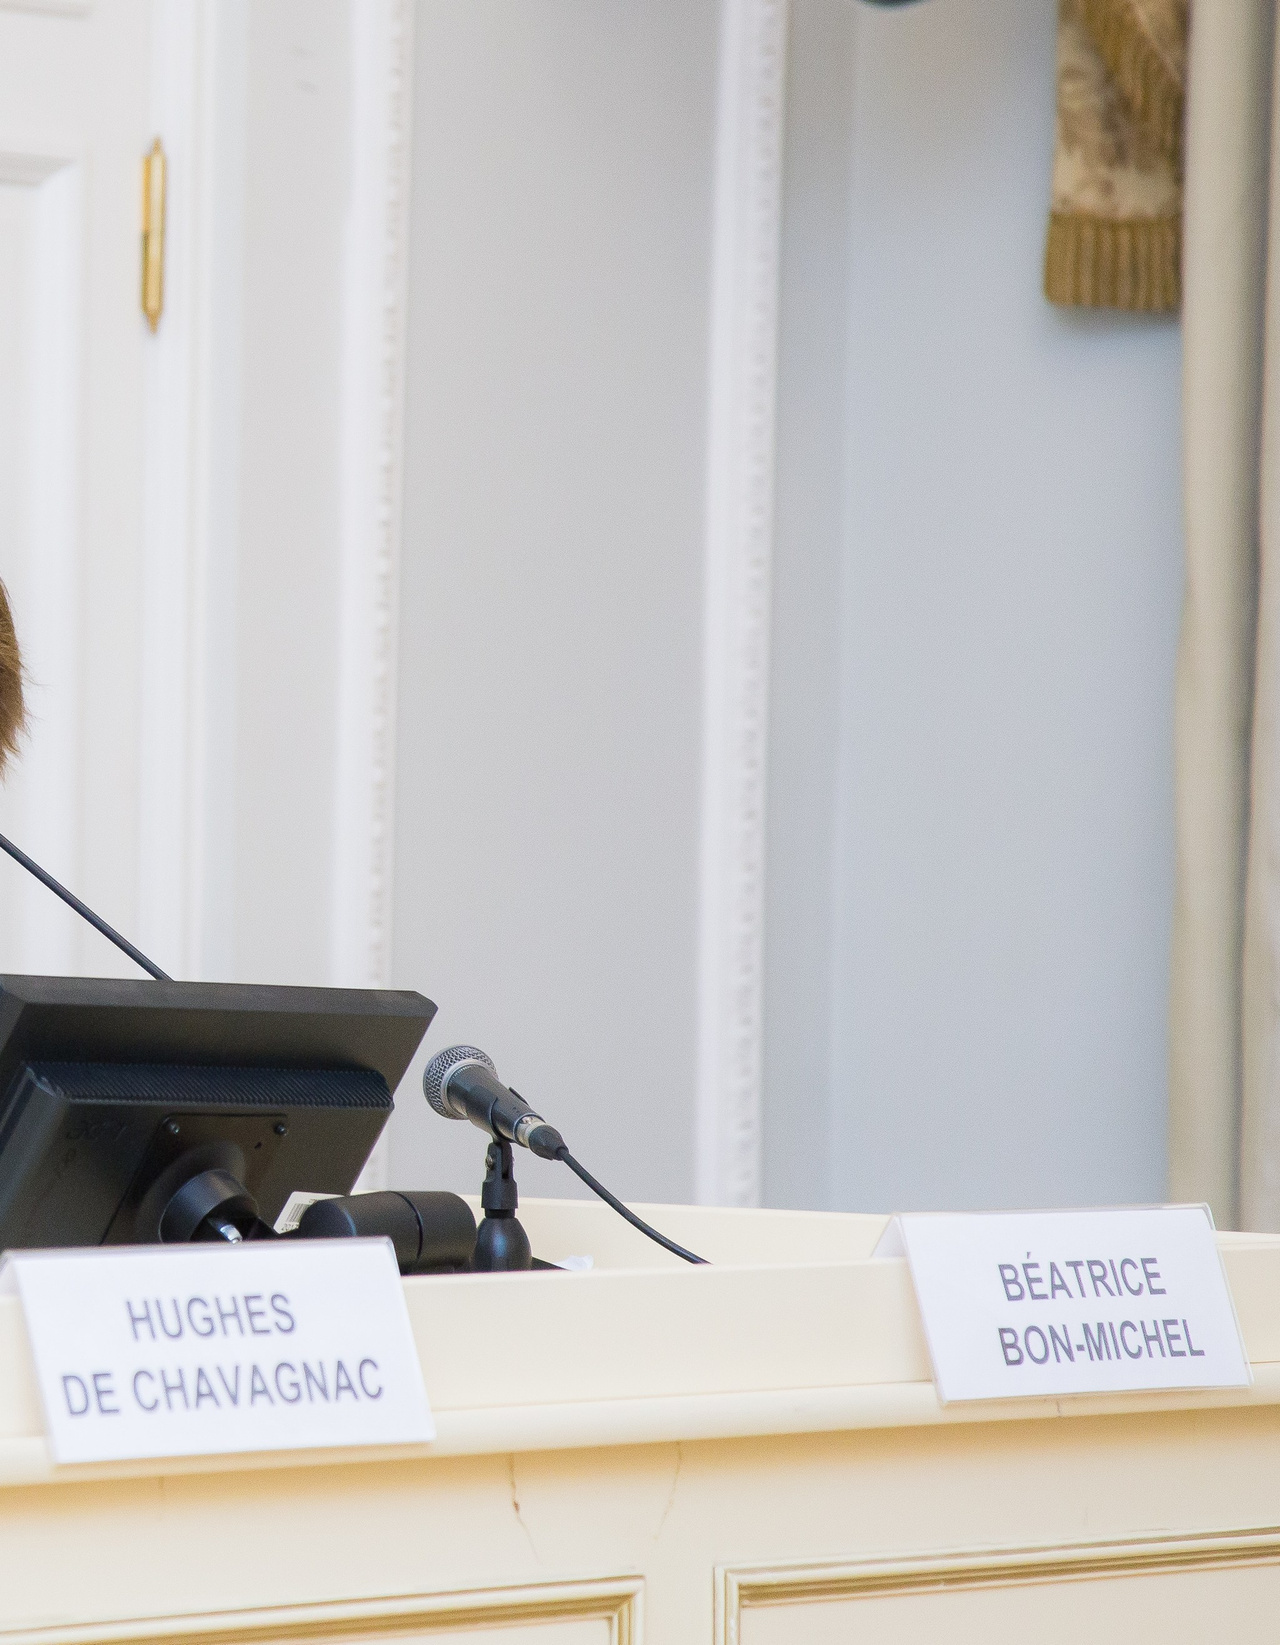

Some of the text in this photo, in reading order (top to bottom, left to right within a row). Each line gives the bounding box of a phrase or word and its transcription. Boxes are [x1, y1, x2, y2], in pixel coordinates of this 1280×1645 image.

[997, 1251, 1167, 1302] BÉATRICE
[126, 1293, 296, 1340] HUGHES
[997, 1318, 1206, 1367] BON-MICHEL
[61, 1357, 385, 1416] DE CHAVAGNAC
